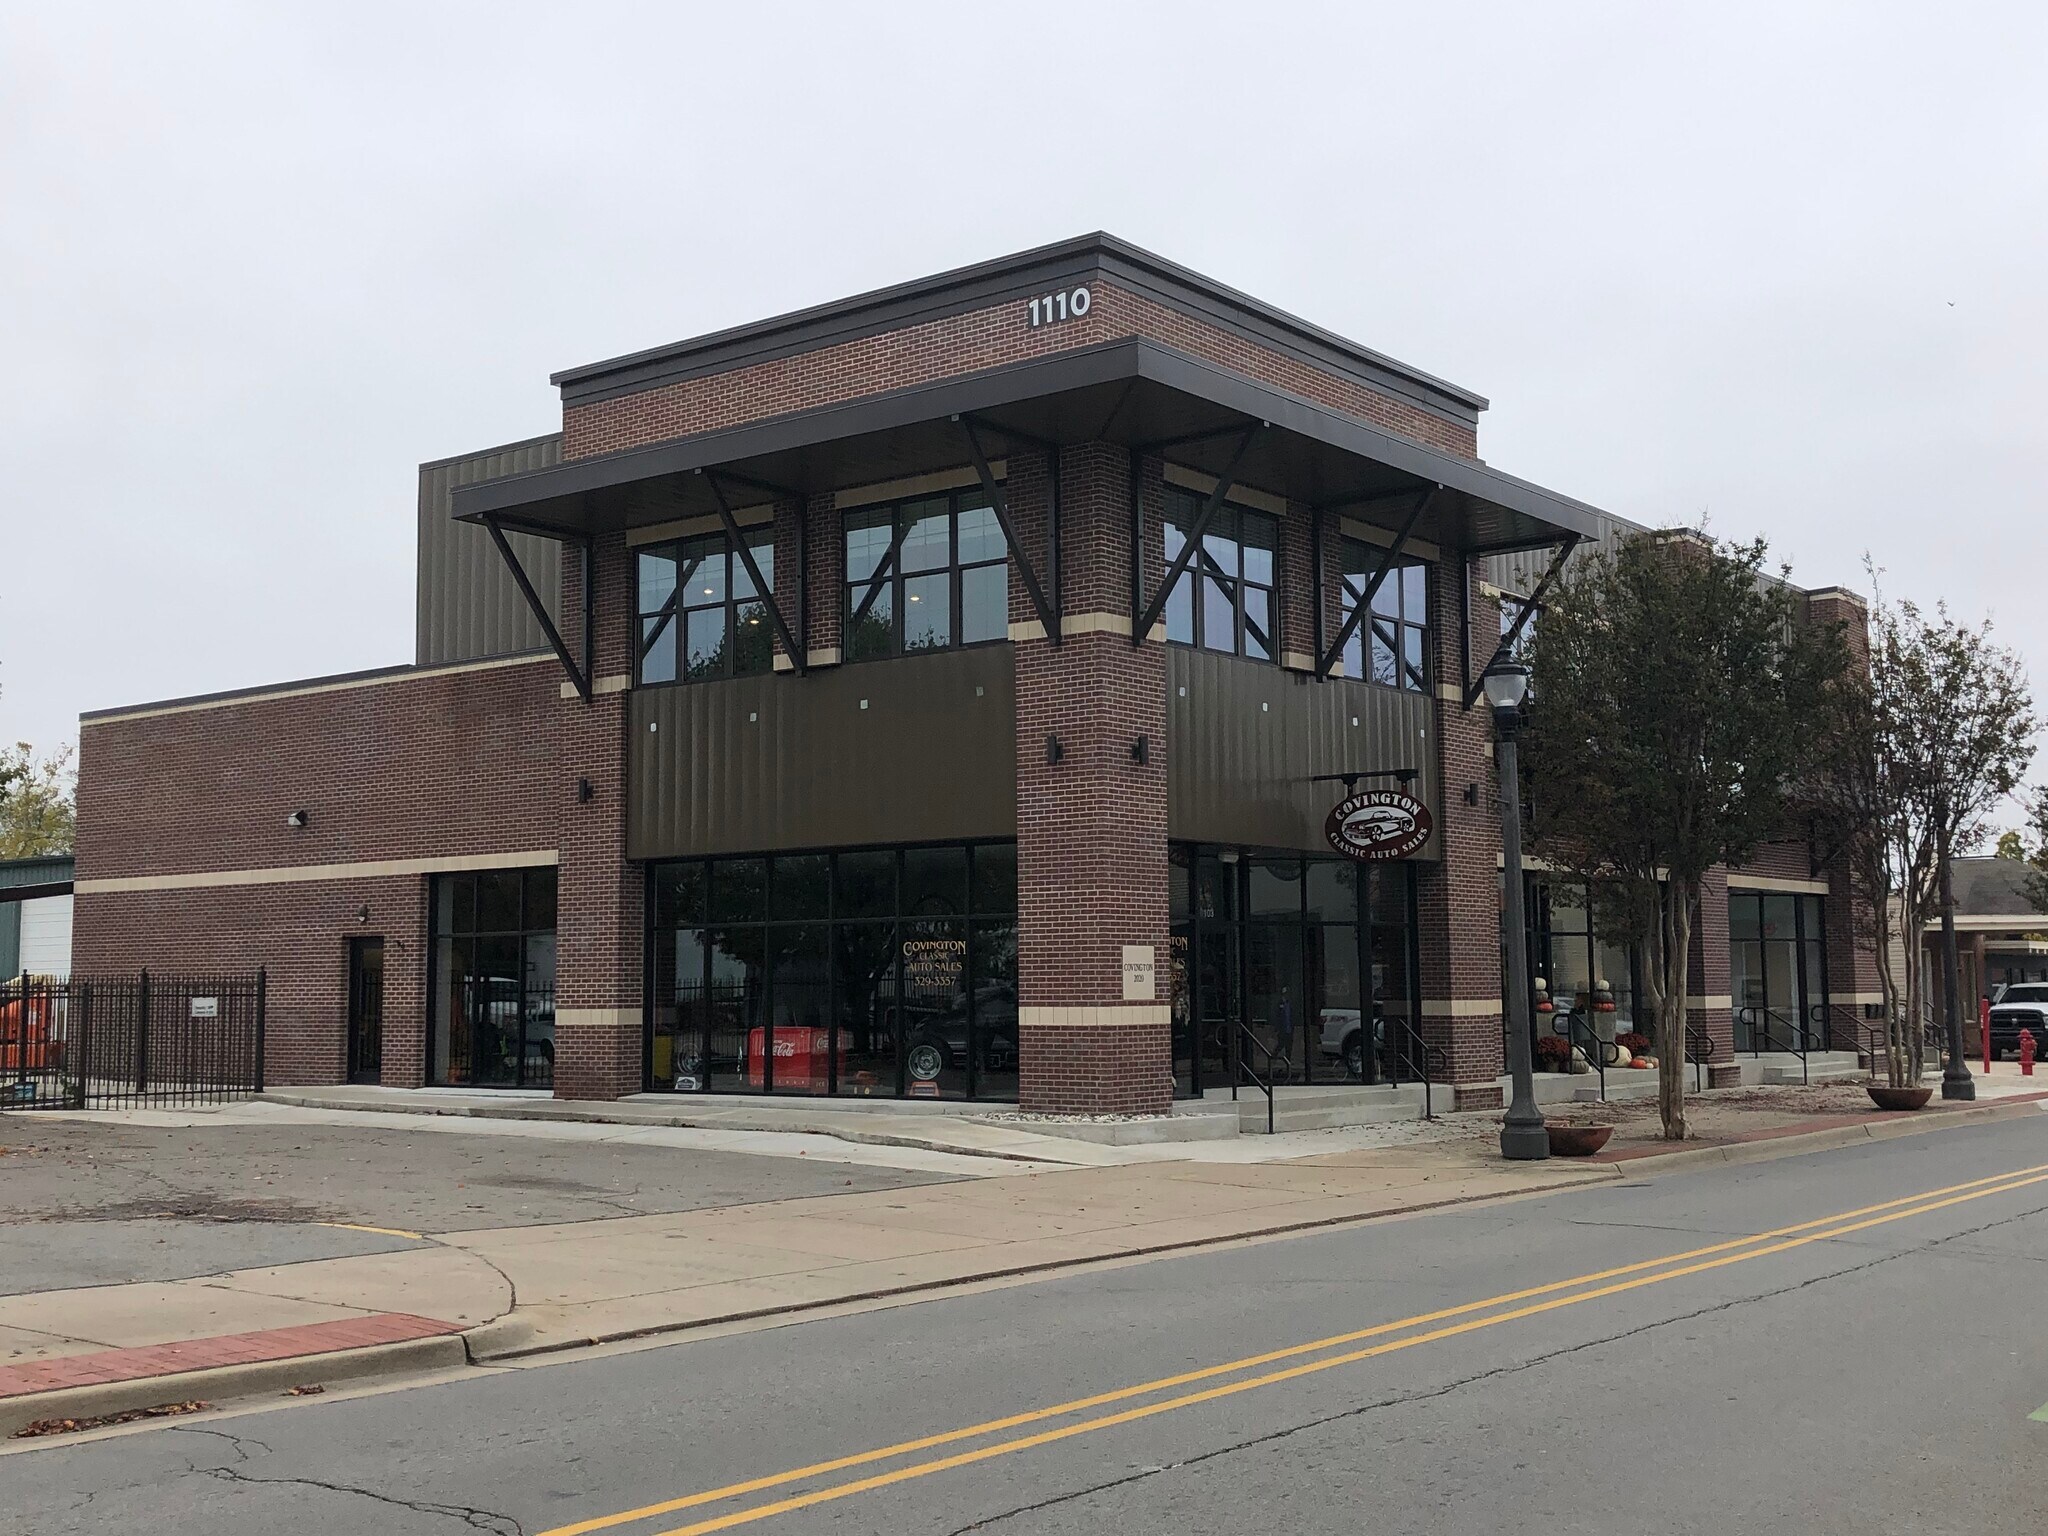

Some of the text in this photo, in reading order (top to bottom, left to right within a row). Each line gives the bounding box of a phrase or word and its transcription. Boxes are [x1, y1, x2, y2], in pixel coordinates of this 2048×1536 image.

[1028, 287, 1091, 327] 1110
[1335, 793, 1421, 820] COVINGTON
[1330, 827, 1428, 859] CLASSIC AUTO SALES
[903, 941, 966, 956] COVINGTON
[920, 952, 949, 960] CLASSIC
[909, 962, 963, 972] AUTO SALES
[1123, 963, 1154, 972] COVINGTON
